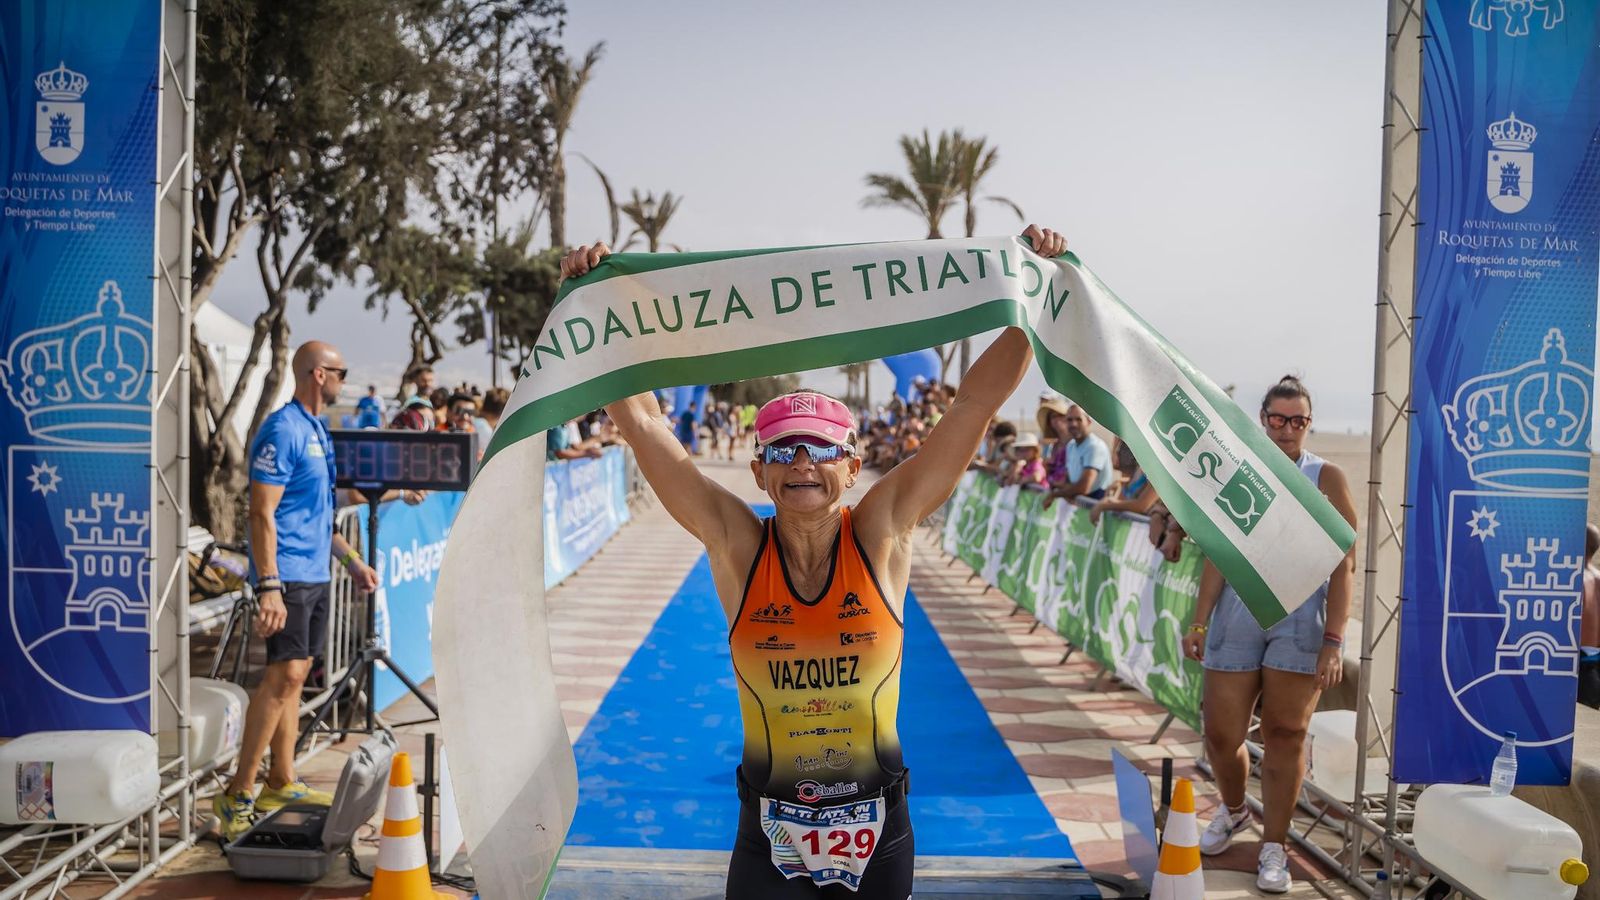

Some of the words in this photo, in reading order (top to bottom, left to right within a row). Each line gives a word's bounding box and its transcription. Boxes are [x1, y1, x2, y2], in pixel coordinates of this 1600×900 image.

[12, 172, 95, 184] AYUNTAMIENTO
[0, 187, 65, 202] OQUETAS
[72, 189, 91, 201] DE
[96, 187, 135, 202] MAR
[5, 206, 57, 219] Delegación
[59, 207, 72, 217] de
[73, 207, 116, 220] Deportes
[25, 221, 31, 232] y
[34, 219, 69, 232] Tiempo
[71, 220, 96, 231] Libre
[1463, 219, 1542, 232] AYUNTAMIENTO
[1544, 223, 1558, 233] DE
[1439, 230, 1514, 249] ROQUETAS
[1520, 237, 1538, 250] DE
[1543, 236, 1579, 251] MAR
[1455, 253, 1505, 266] Delegación
[1507, 255, 1519, 265] de
[1521, 255, 1562, 268] Deportes
[1474, 269, 1481, 278] y
[1483, 267, 1516, 279] Tiempo
[1518, 269, 1542, 279] Libre
[771, 269, 837, 316] DE
[1171, 389, 1207, 430] Federación
[1207, 429, 1241, 466] Andaluza
[1239, 465, 1250, 476] de
[768, 655, 860, 691] VAZQUEZ
[801, 828, 876, 859] 129
